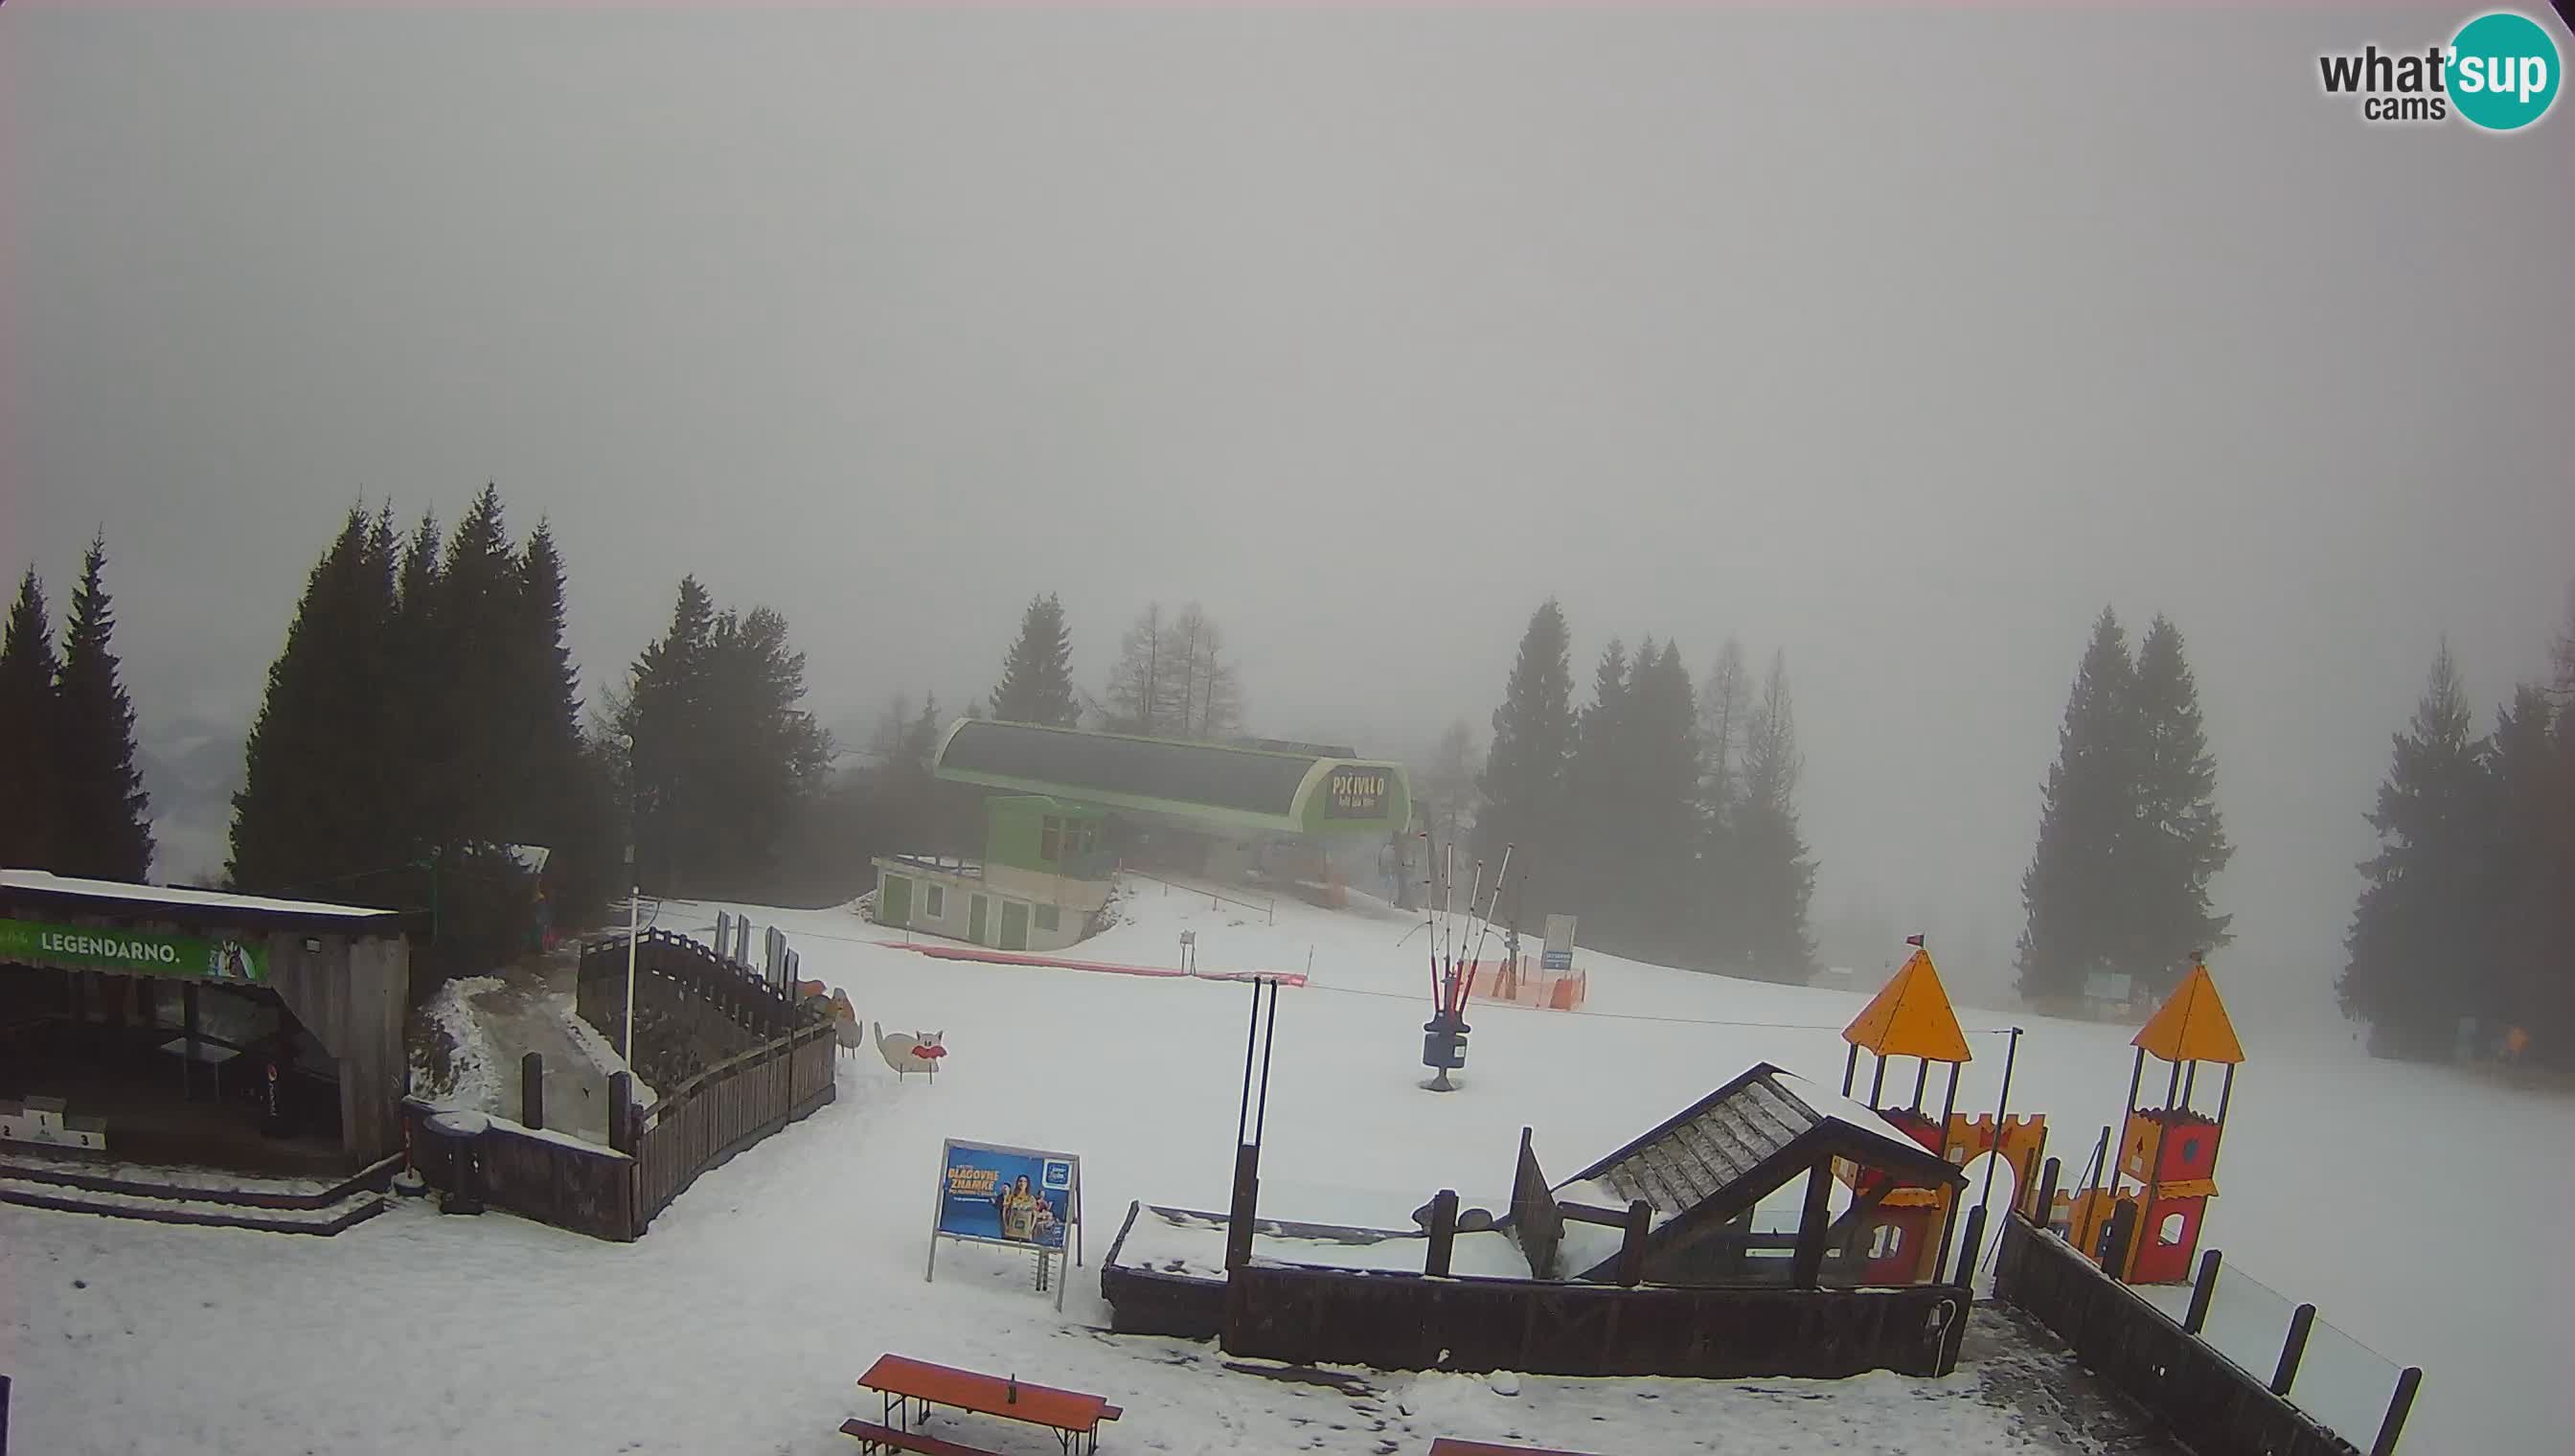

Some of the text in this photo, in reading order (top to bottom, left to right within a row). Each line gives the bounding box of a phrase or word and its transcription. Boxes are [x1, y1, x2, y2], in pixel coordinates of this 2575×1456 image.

[41, 932, 181, 964] LEGENDARNO.
[39, 1114, 46, 1126] 1
[3, 1125, 11, 1137] 2
[80, 1134, 89, 1147] 3
[951, 1178, 994, 1191] ZNAMKE
